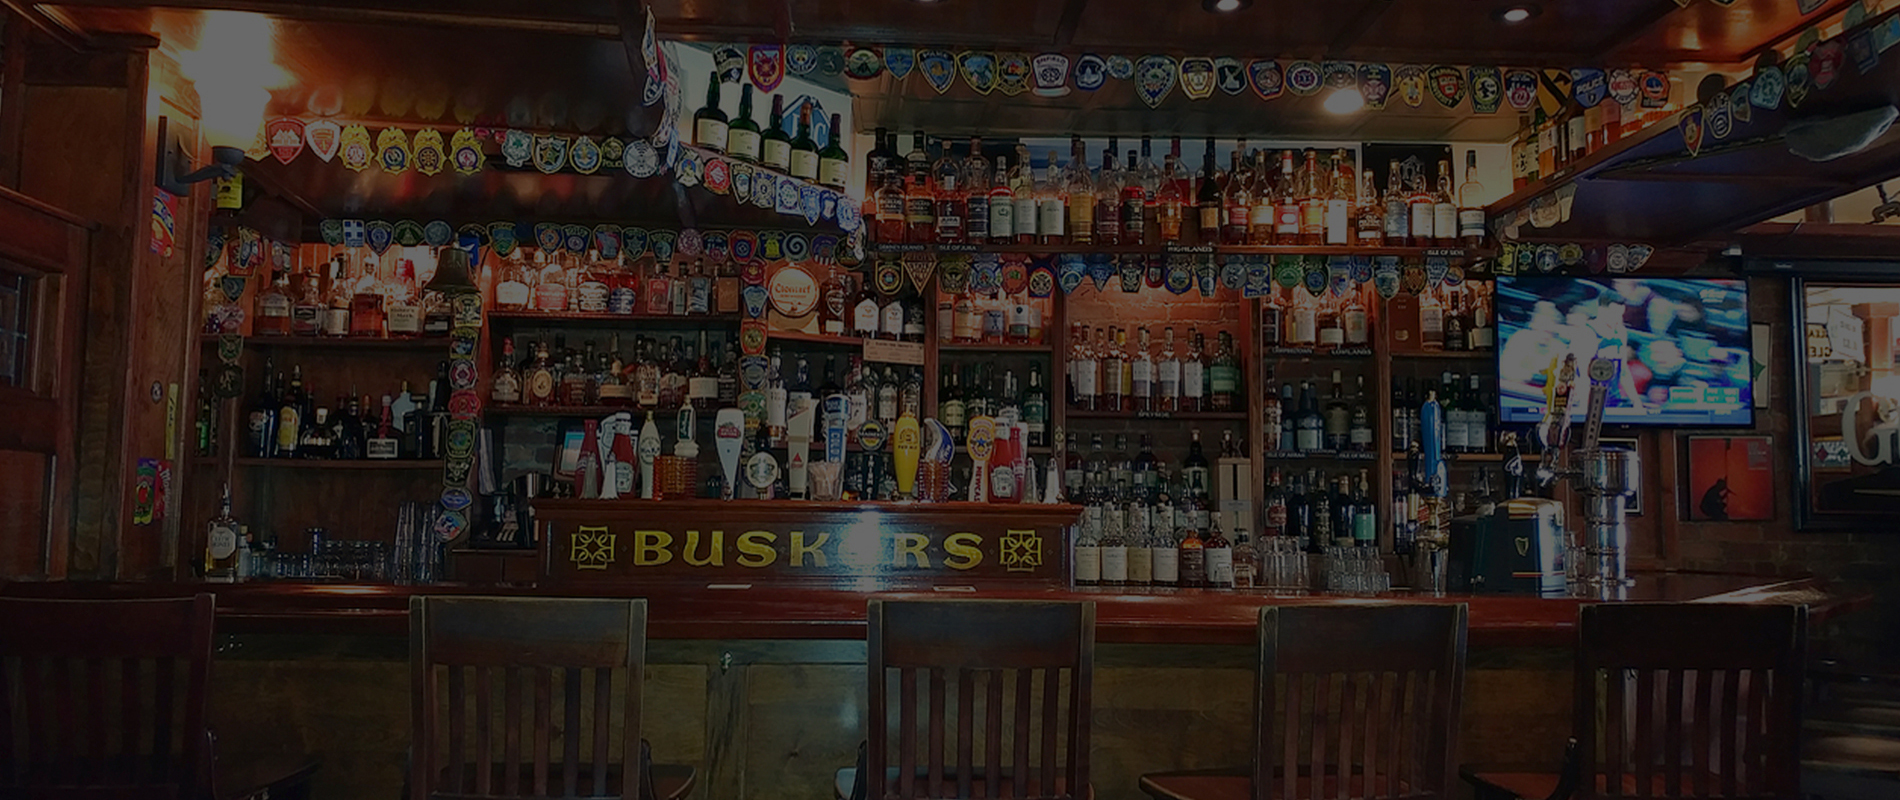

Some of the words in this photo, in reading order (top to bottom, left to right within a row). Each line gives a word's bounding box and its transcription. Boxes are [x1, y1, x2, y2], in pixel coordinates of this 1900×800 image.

[1576, 76, 1605, 95] POLICE
[1842, 391, 1899, 466] G
[632, 529, 985, 570] BUSKRS
